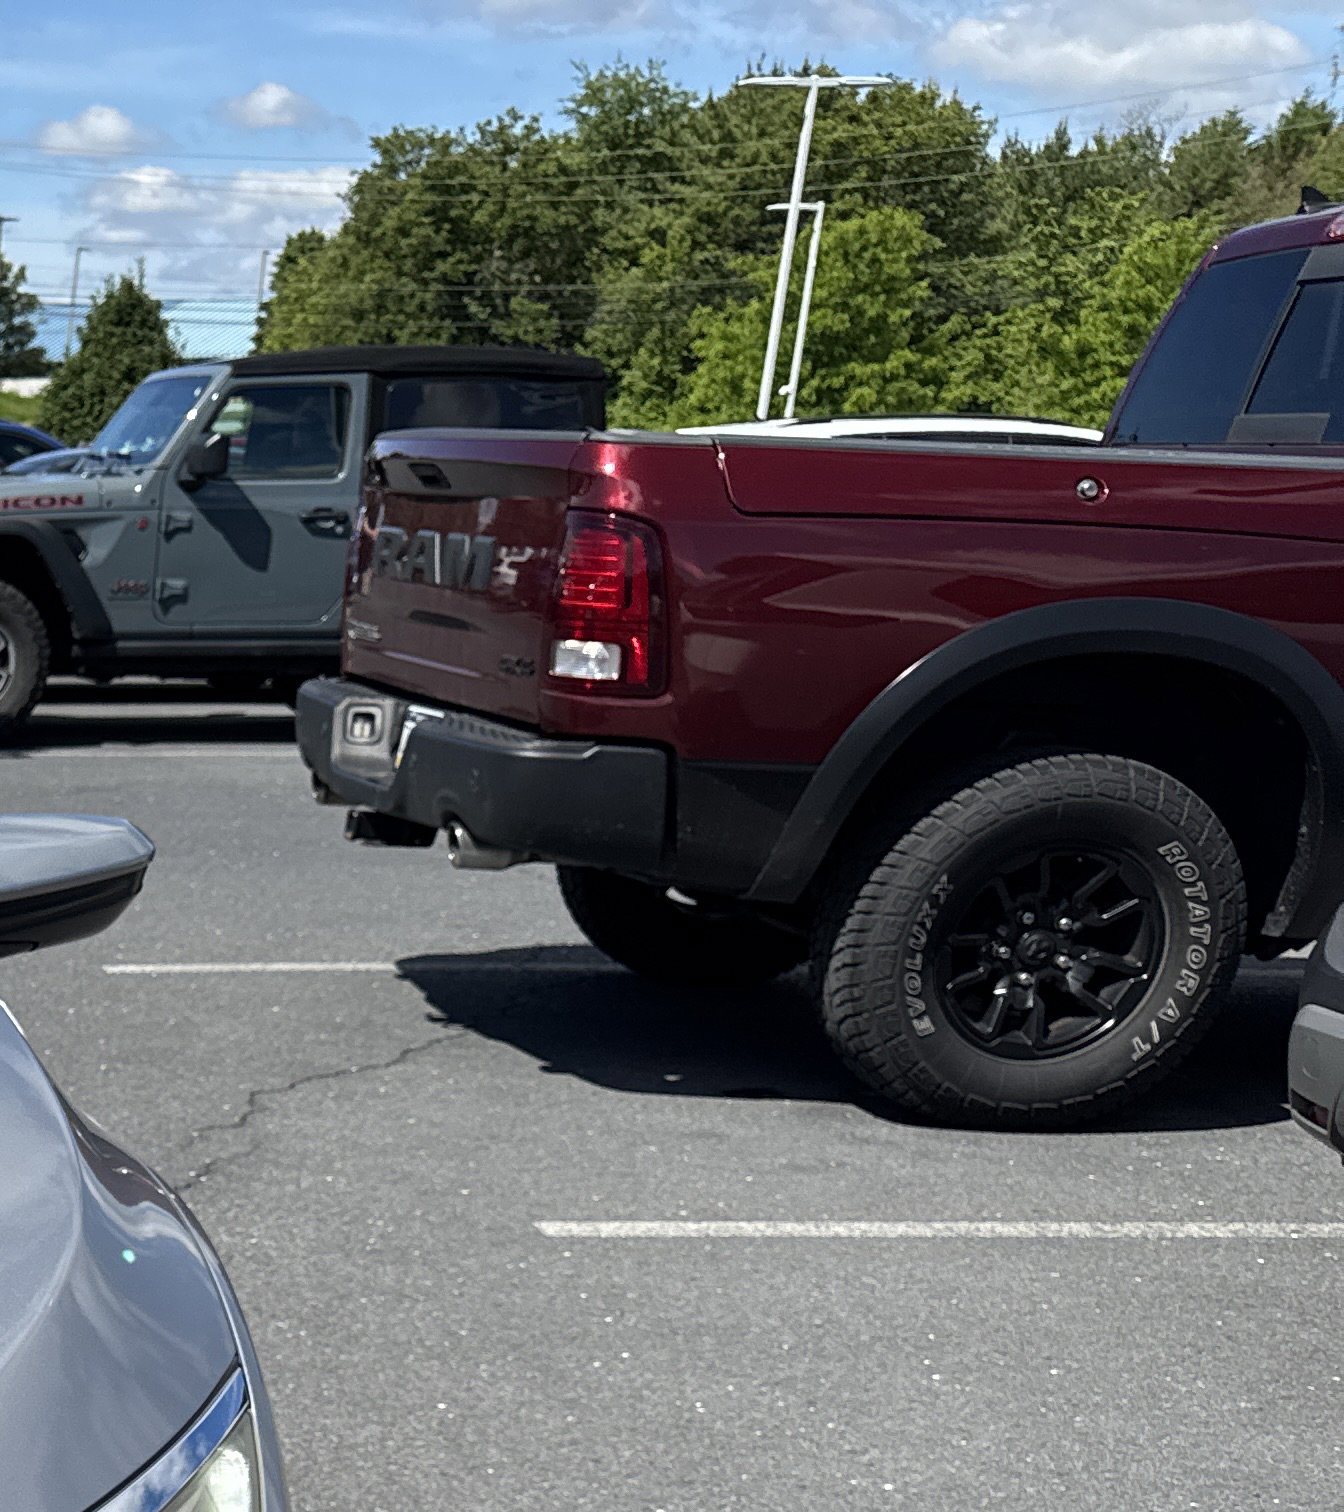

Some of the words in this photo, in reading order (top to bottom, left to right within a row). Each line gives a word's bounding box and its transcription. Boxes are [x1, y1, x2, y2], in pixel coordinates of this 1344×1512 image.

[372, 526, 497, 592] RAM
[1157, 840, 1212, 997] ROTATOR
[1130, 997, 1181, 1062] A/T
